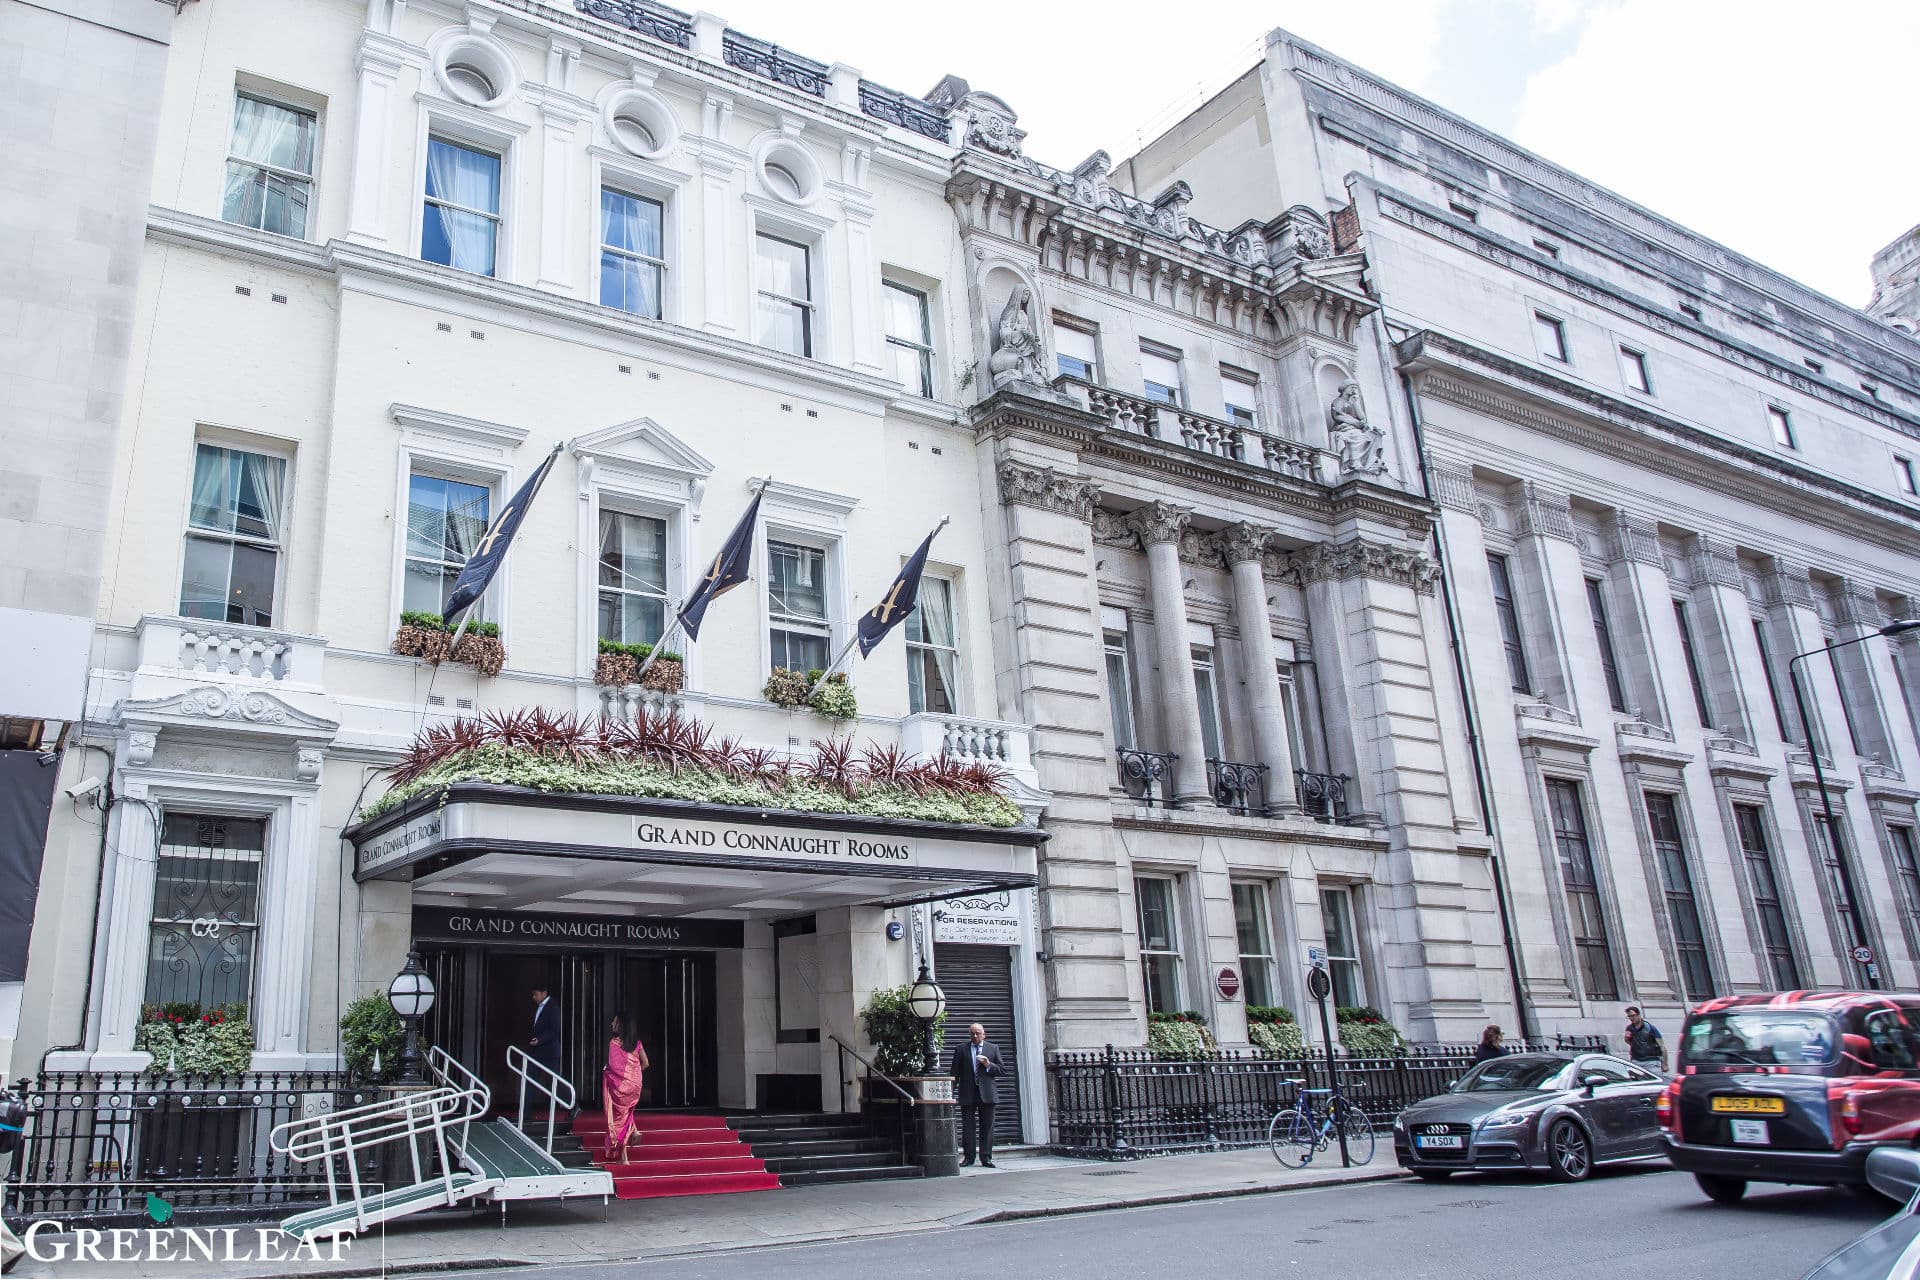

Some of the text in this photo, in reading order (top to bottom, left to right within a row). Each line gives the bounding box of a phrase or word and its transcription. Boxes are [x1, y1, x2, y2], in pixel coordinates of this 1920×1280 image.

[362, 846, 382, 864] GRAND
[418, 822, 441, 842] ROOMS
[637, 823, 909, 860] GRAND CONNAUGHT ROOMS
[449, 916, 680, 940] GRAND CONNAUGHT ROOMS
[957, 917, 1018, 927] RESERVATIONS
[1855, 950, 1870, 958] 20
[1425, 1136, 1454, 1146] Y4 SOX
